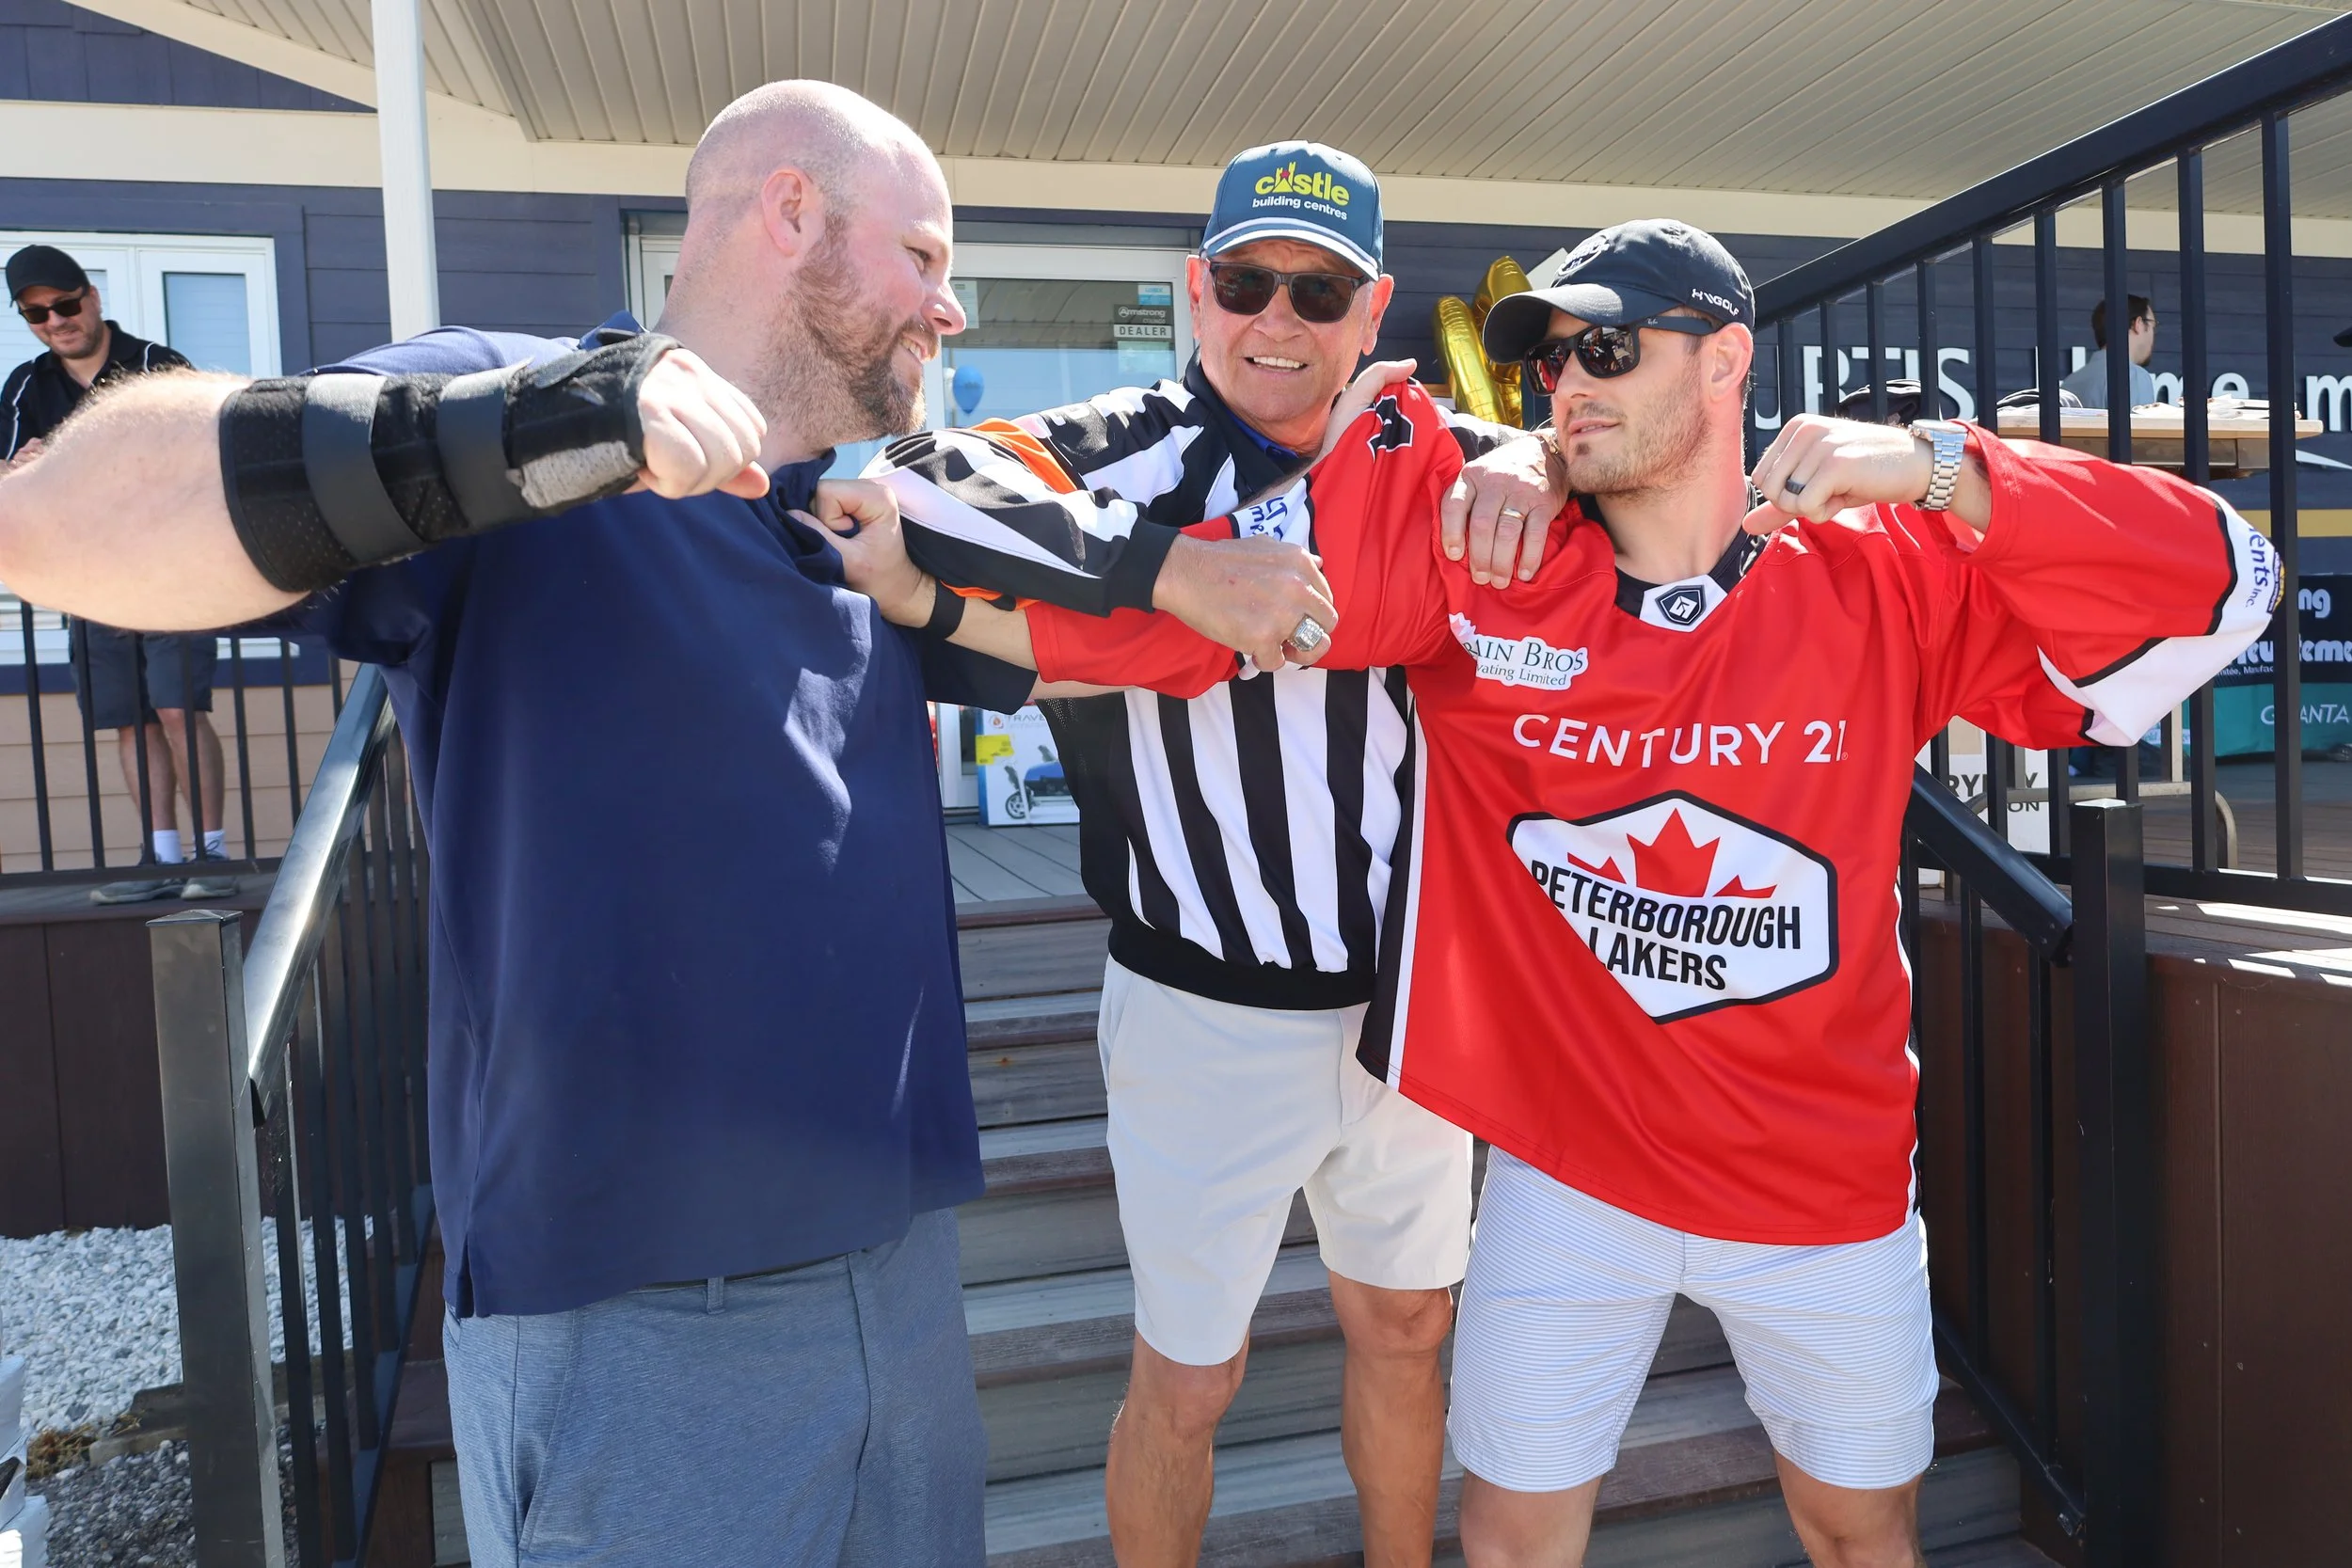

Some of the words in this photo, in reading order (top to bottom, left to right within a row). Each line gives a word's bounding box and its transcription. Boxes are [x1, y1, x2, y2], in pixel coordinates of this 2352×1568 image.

[1255, 162, 1350, 206] castle
[1252, 196, 1301, 209] building
[1304, 200, 1347, 220] centres
[1119, 306, 1166, 318] Armstrong
[1120, 325, 1167, 336] DEALER
[2249, 528, 2271, 588] ents
[1518, 671, 1567, 687] Limited
[1512, 713, 1786, 768] CENTURY
[1531, 859, 1802, 950] PETERBOROUGH
